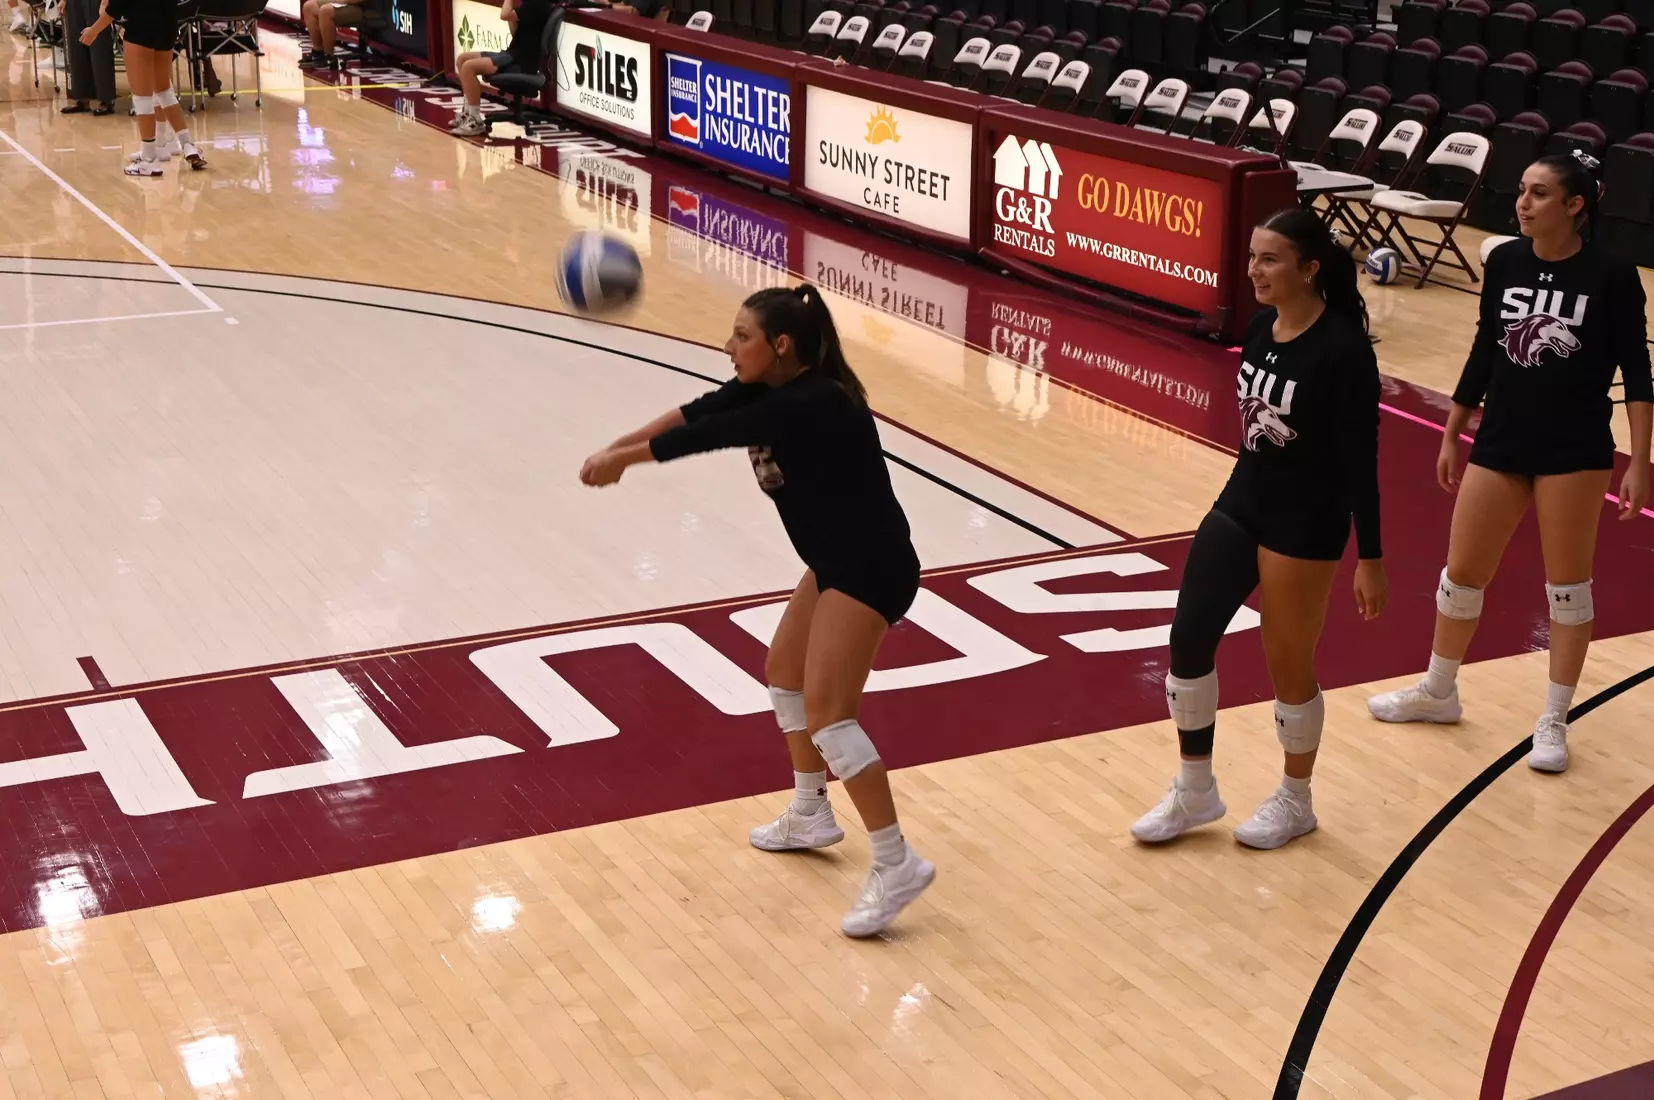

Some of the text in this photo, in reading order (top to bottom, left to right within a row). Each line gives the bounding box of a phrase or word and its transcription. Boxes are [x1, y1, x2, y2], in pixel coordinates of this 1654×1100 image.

[400, 11, 412, 35] SIH
[671, 76, 697, 94] SHELTER
[671, 88, 697, 103] INSURANCE
[705, 73, 790, 133] SHELTER
[579, 92, 634, 120] OFFICE SOLUTIONS
[819, 140, 950, 202] SUNNY STREET
[863, 187, 899, 214] CAFE
[995, 187, 1055, 234] G&R
[1078, 173, 1203, 238] GO DAWGS!
[994, 223, 1055, 257] RENTALS
[1066, 231, 1218, 287] WWW.GRRENTALS.COM
[1500, 287, 1589, 326] SIU
